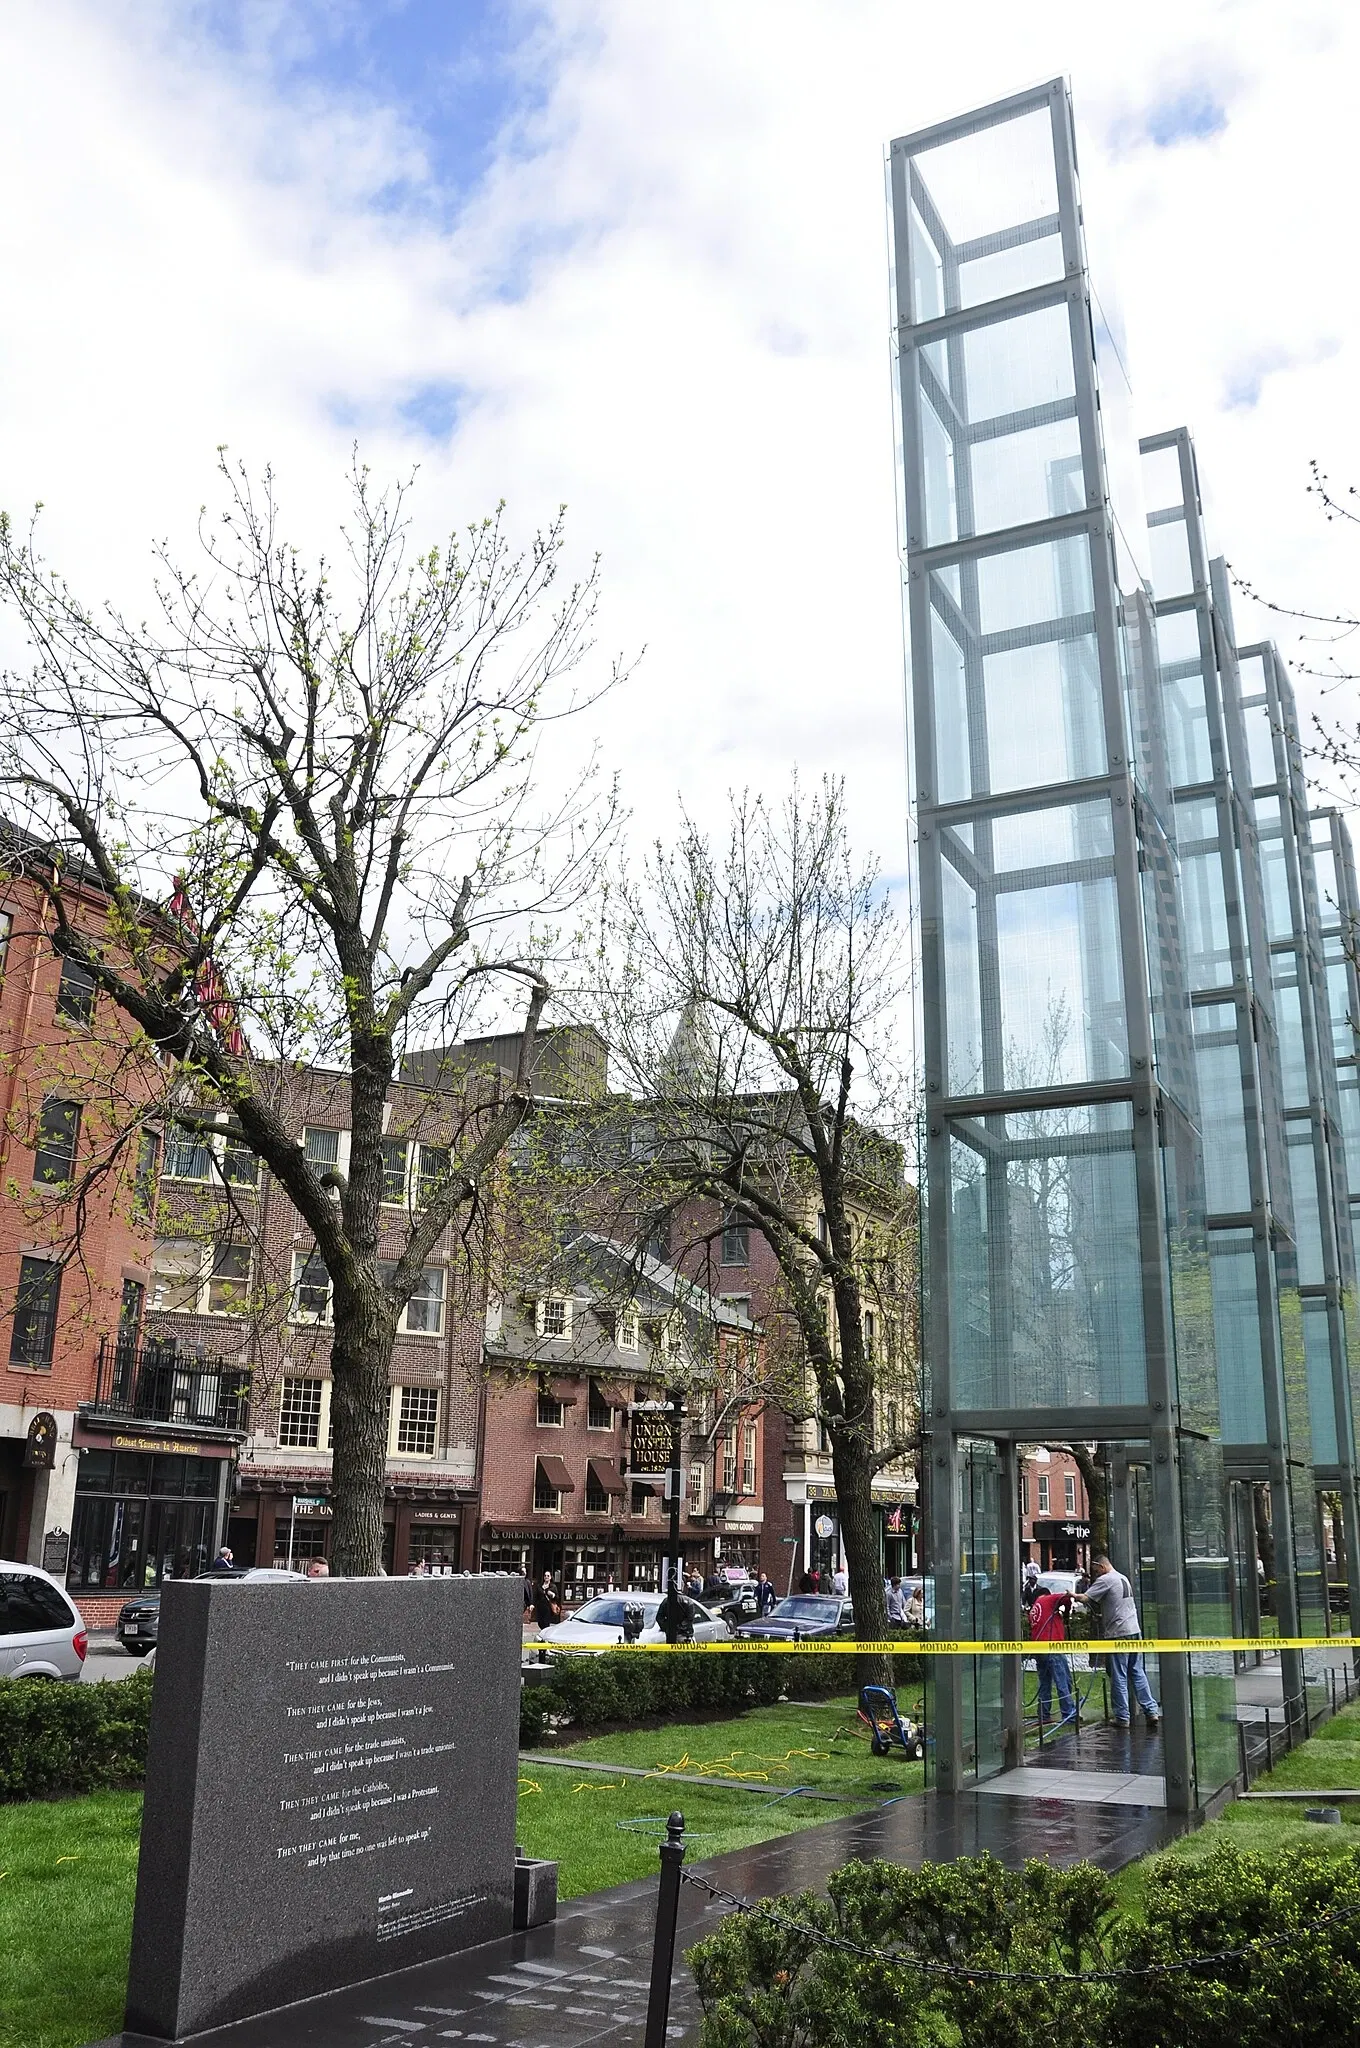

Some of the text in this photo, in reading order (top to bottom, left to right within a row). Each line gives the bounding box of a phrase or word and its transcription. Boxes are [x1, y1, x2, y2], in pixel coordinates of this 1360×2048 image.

[636, 1424, 672, 1436] UNION
[116, 1436, 136, 1447] Oldest
[139, 1438, 160, 1449] Tavern
[172, 1442, 198, 1454] America
[634, 1438, 673, 1450] OYSTER
[636, 1450, 670, 1462] HOUSE
[294, 1506, 314, 1514] THE
[740, 1523, 754, 1531] GOODS
[1076, 1525, 1090, 1538] the
[310, 1660, 328, 1669] CAME
[331, 1658, 348, 1667] FIRST
[350, 1656, 360, 1665] for
[360, 1655, 370, 1665] the
[319, 1673, 330, 1683] and
[335, 1672, 352, 1682] didn't
[353, 1670, 369, 1683] speak
[370, 1672, 378, 1682] up
[378, 1668, 399, 1678] because
[287, 1706, 306, 1716] THEN
[308, 1704, 325, 1714] THEY
[327, 1702, 345, 1712] CAME
[347, 1700, 356, 1710] for
[357, 1698, 366, 1708] the
[316, 1718, 328, 1728] and
[332, 1715, 350, 1726] didn't
[351, 1713, 366, 1727] speak
[368, 1714, 375, 1724] up
[376, 1710, 397, 1721] because
[284, 1754, 304, 1763] THEN
[305, 1750, 322, 1760] THEY
[324, 1747, 342, 1756] CAME
[344, 1744, 354, 1754] for
[355, 1742, 364, 1752] the
[365, 1738, 380, 1750] trade
[314, 1763, 325, 1774] and
[330, 1760, 348, 1771] didn't
[348, 1756, 364, 1772] speak
[365, 1758, 373, 1768] up
[374, 1754, 395, 1763] because
[421, 1744, 434, 1754] trade
[280, 1781, 390, 1811] THEN THEY CAME for the Catholics,
[310, 1808, 321, 1820] and
[326, 1804, 344, 1816] didn't
[346, 1800, 361, 1816] speak
[362, 1801, 370, 1812] up
[371, 1797, 392, 1807] because
[412, 1786, 440, 1798] Protestant.
[277, 1832, 361, 1859] THEN THEY CAME for me,
[308, 1854, 319, 1867] and
[320, 1854, 328, 1867] by
[328, 1851, 340, 1861] that
[342, 1848, 355, 1858] time
[356, 1846, 364, 1855] no
[364, 1844, 376, 1852] one
[376, 1840, 387, 1848] was
[388, 1835, 397, 1846] left
[406, 1830, 420, 1844] speak
